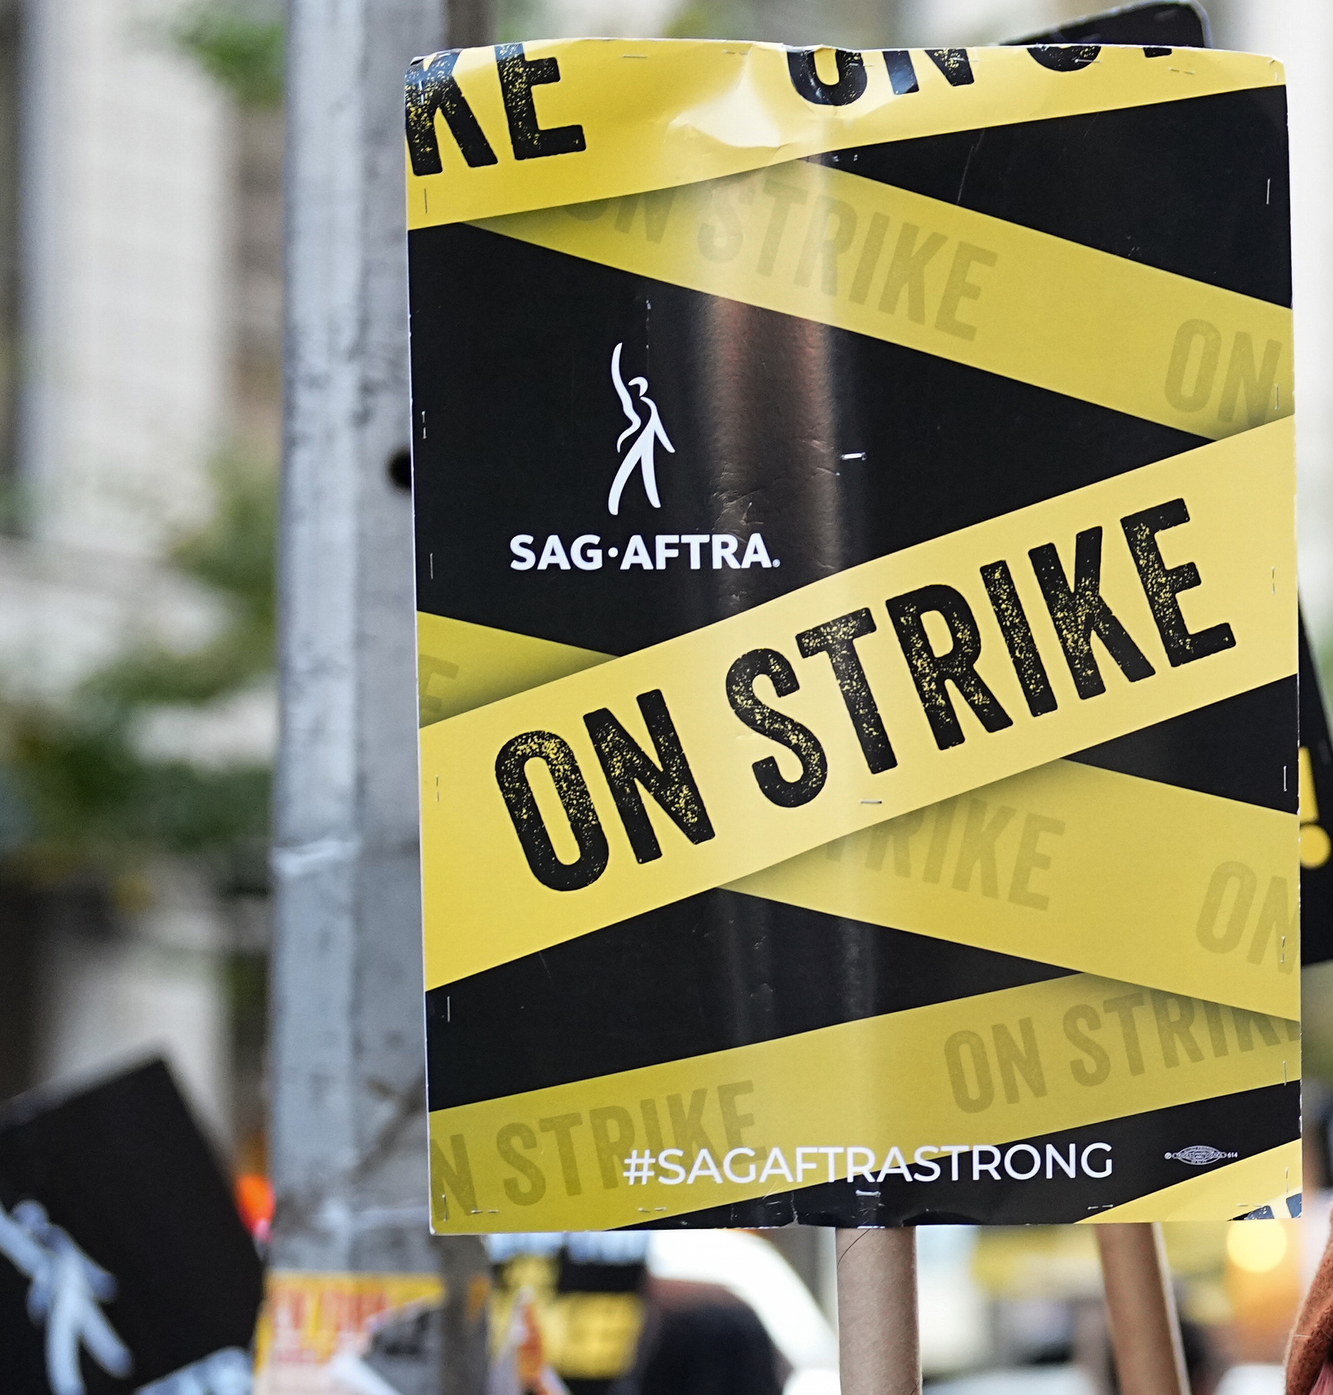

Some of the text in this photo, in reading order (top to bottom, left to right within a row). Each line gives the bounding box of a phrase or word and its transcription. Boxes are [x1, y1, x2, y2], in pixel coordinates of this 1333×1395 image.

[698, 177, 998, 342] STRIKE
[1164, 318, 1283, 430] ON
[495, 498, 1237, 892] ON STRIKE
[826, 797, 1067, 912] RIKE
[1195, 860, 1300, 975] ON
[943, 992, 1300, 1114] ON STRI
[496, 1079, 768, 1207] STRIKE
[623, 1142, 1114, 1186] #SAGAFTRASTRONG
